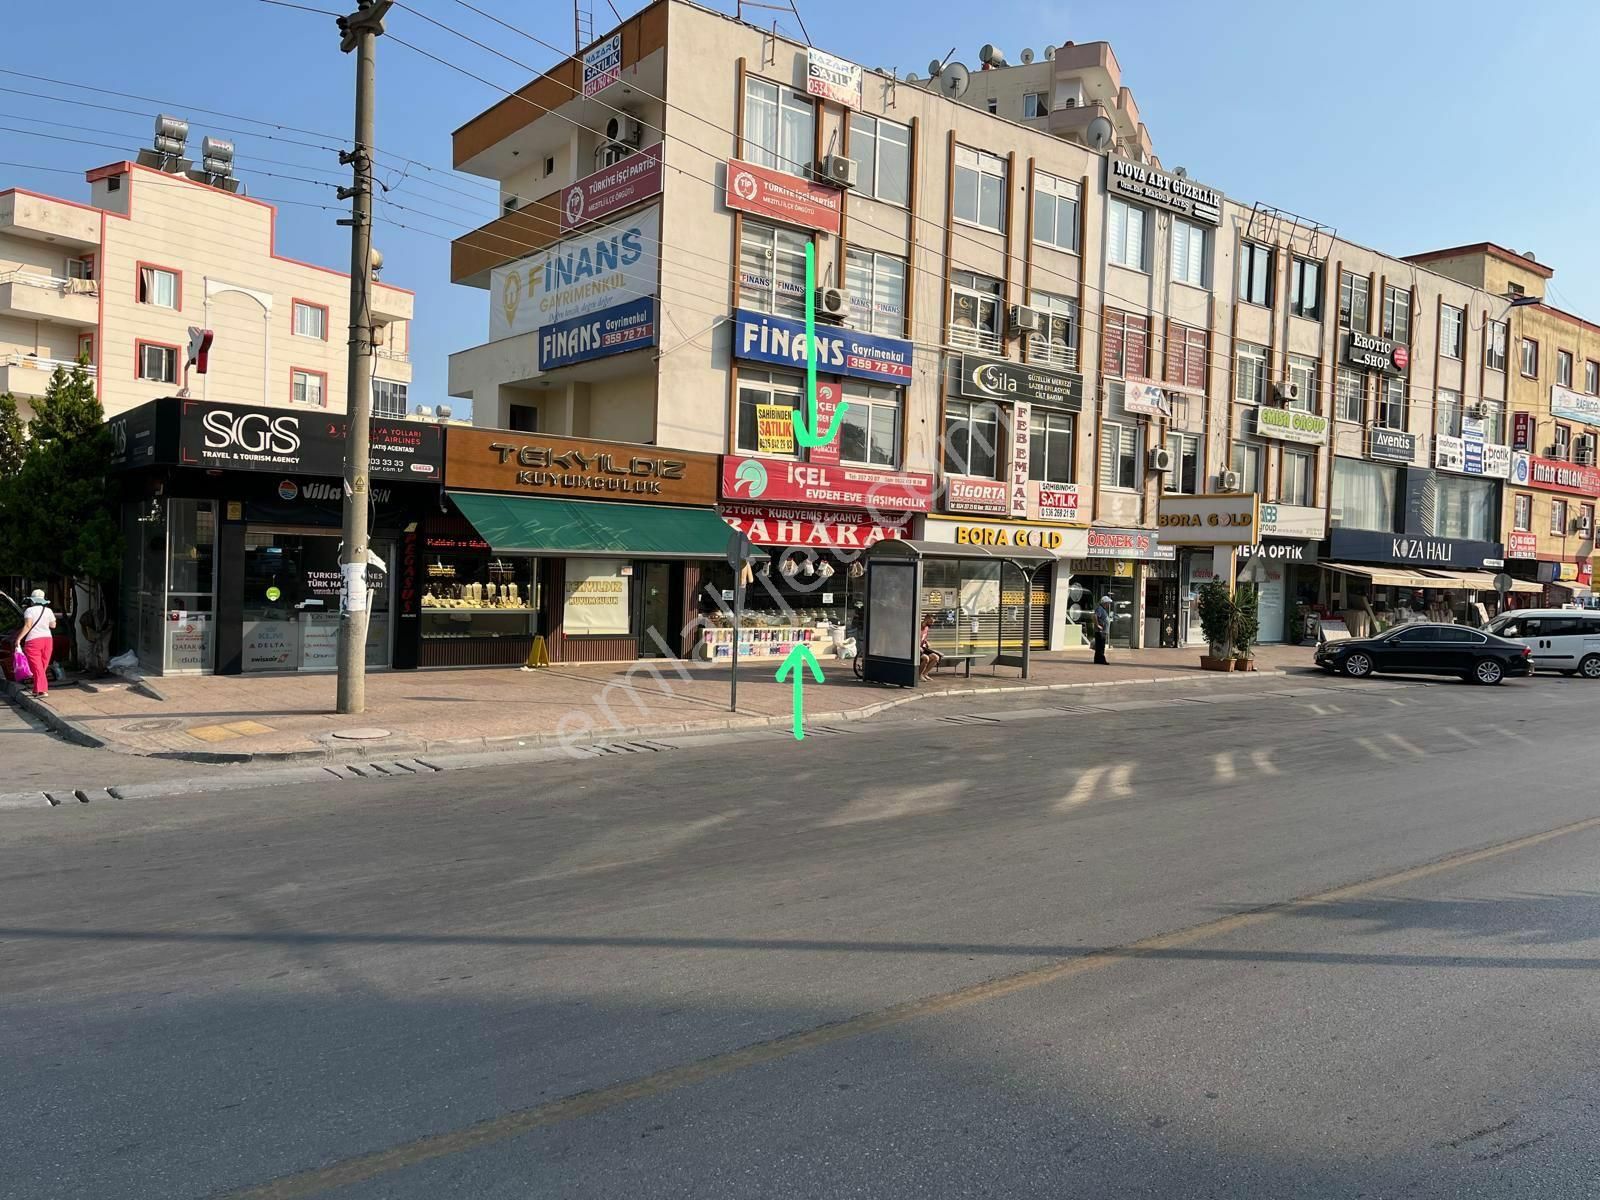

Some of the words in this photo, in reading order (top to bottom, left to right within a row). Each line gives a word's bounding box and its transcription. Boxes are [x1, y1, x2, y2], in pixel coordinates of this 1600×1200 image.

[586, 52, 619, 80] SATILIK
[589, 175, 615, 195] TÜRKİYE
[616, 166, 629, 184] İŞÇİ
[630, 154, 656, 176] PARTİSİ
[740, 179, 752, 187] TİP
[1116, 160, 1146, 182] NOVA
[1149, 172, 1171, 189] ART
[1173, 178, 1221, 207] GÜZELLİK
[764, 181, 795, 197] TÜRKİYE
[810, 195, 836, 209] PARTİSİ
[539, 273, 626, 312] GAYRİMENKUL
[543, 321, 601, 364] FİNANS
[605, 310, 647, 330] Gayrimenkul
[604, 331, 623, 344] 359
[624, 329, 635, 340] 72
[636, 326, 647, 339] 71
[744, 319, 844, 366] FİNANS
[852, 344, 904, 363] Gayrimenkul
[851, 357, 872, 369] 359
[875, 361, 889, 372] 72
[891, 365, 904, 375] 71
[1364, 354, 1390, 369] SHOP
[758, 409, 791, 420] SAHİBİNDEN
[1292, 413, 1326, 434] GROUP
[202, 410, 301, 454] SGS
[391, 429, 421, 437] YOLLARI
[759, 421, 792, 437] SATILIK
[385, 437, 421, 445] AIRLINES
[1376, 432, 1410, 449] Aventis
[202, 450, 231, 459] TRAVEL
[240, 453, 271, 462] TOURISM
[272, 456, 300, 464] AGENCY
[489, 442, 686, 479] TEKYILDIZ
[518, 470, 662, 494] KUYUMCULUK
[787, 462, 831, 488] İÇEL
[303, 483, 342, 500] Villa
[806, 489, 840, 501] EVDEN
[843, 492, 862, 502] EVE
[867, 494, 926, 508] TAŞIMACILIK
[951, 483, 1007, 500] SİGORTA
[1041, 493, 1077, 507] SATILIK
[768, 507, 823, 524] KURUYEMİŞ
[832, 512, 863, 524] KAHVE
[1063, 509, 1069, 517] 21
[1159, 513, 1202, 527] BORA
[1207, 513, 1252, 527] GOLD
[722, 515, 908, 547] BAHARAT
[957, 526, 1009, 546] BORA
[1015, 529, 1063, 549] GOLD
[1088, 529, 1134, 548] ÖRNEK
[1136, 533, 1150, 553] İŞ
[1392, 538, 1424, 559] KOZA
[1426, 541, 1452, 561] HALI
[308, 580, 328, 588] TÜRK
[566, 581, 623, 592] TEKYILDIZ
